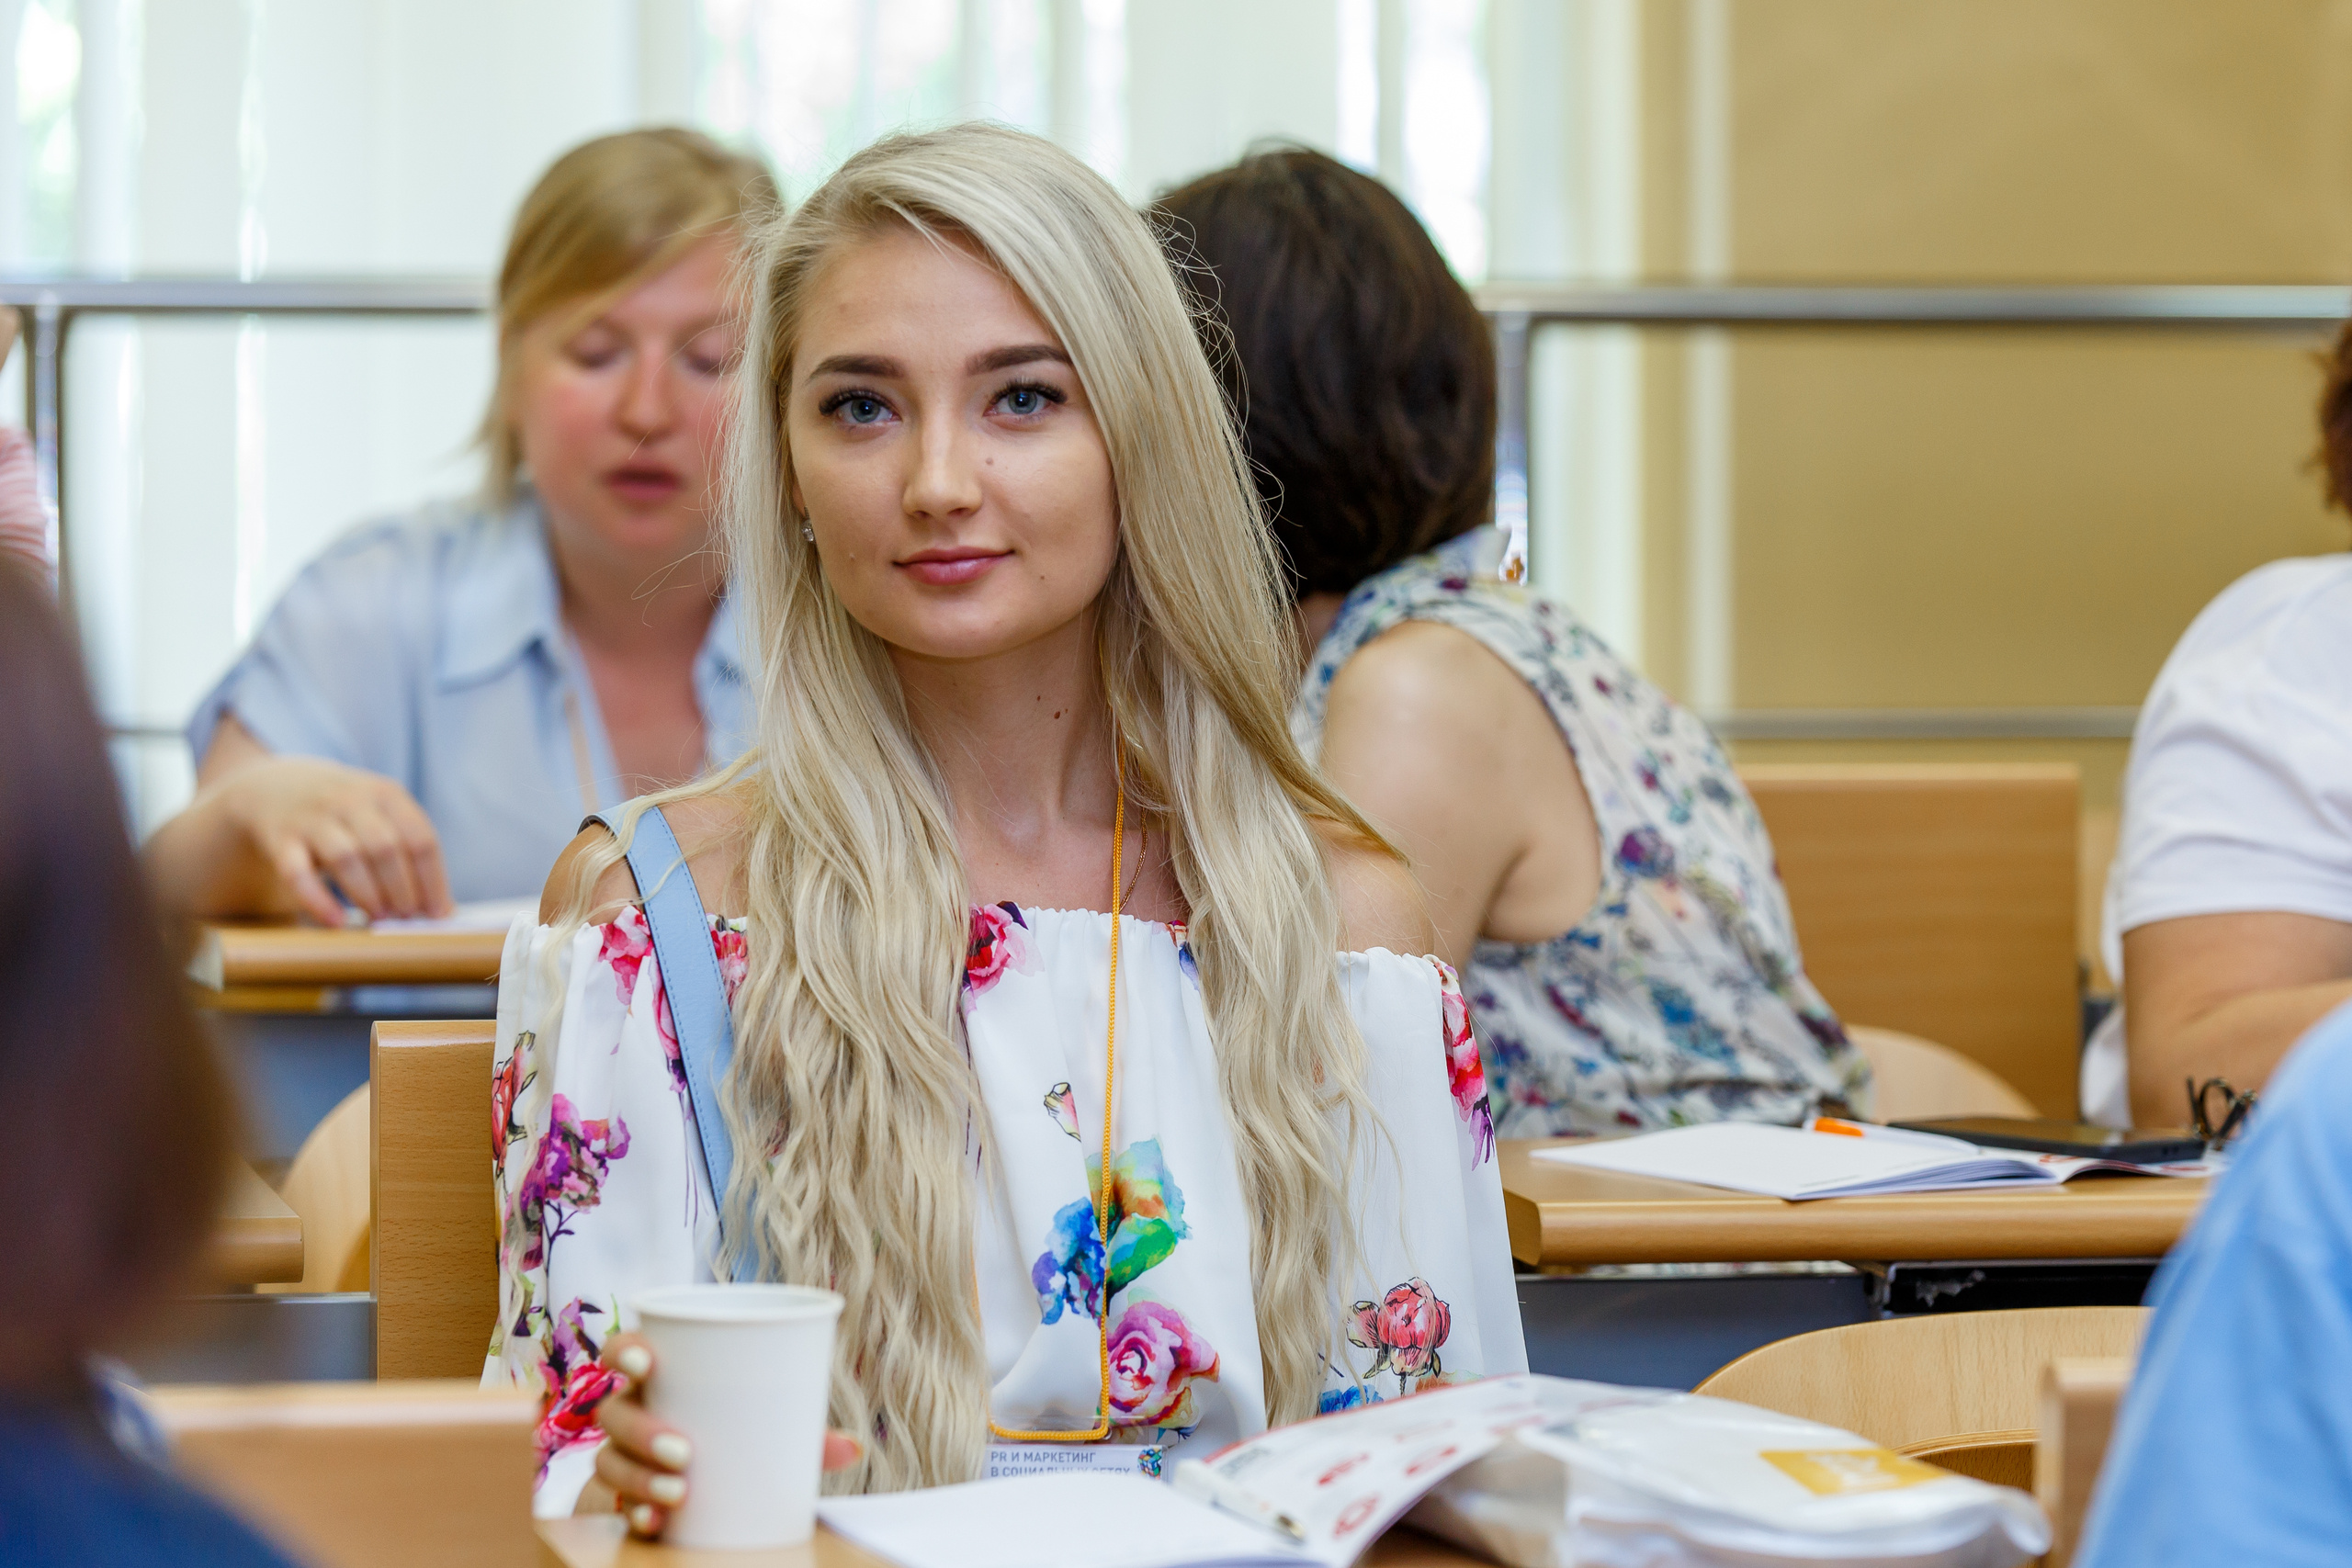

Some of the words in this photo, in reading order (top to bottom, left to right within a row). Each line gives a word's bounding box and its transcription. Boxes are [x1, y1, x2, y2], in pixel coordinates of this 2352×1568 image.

[990, 1451, 1008, 1462] PR
[1012, 1451, 1020, 1462] И
[1023, 1451, 1096, 1462] МАРКЕТИНГ
[990, 1466, 999, 1477] В
